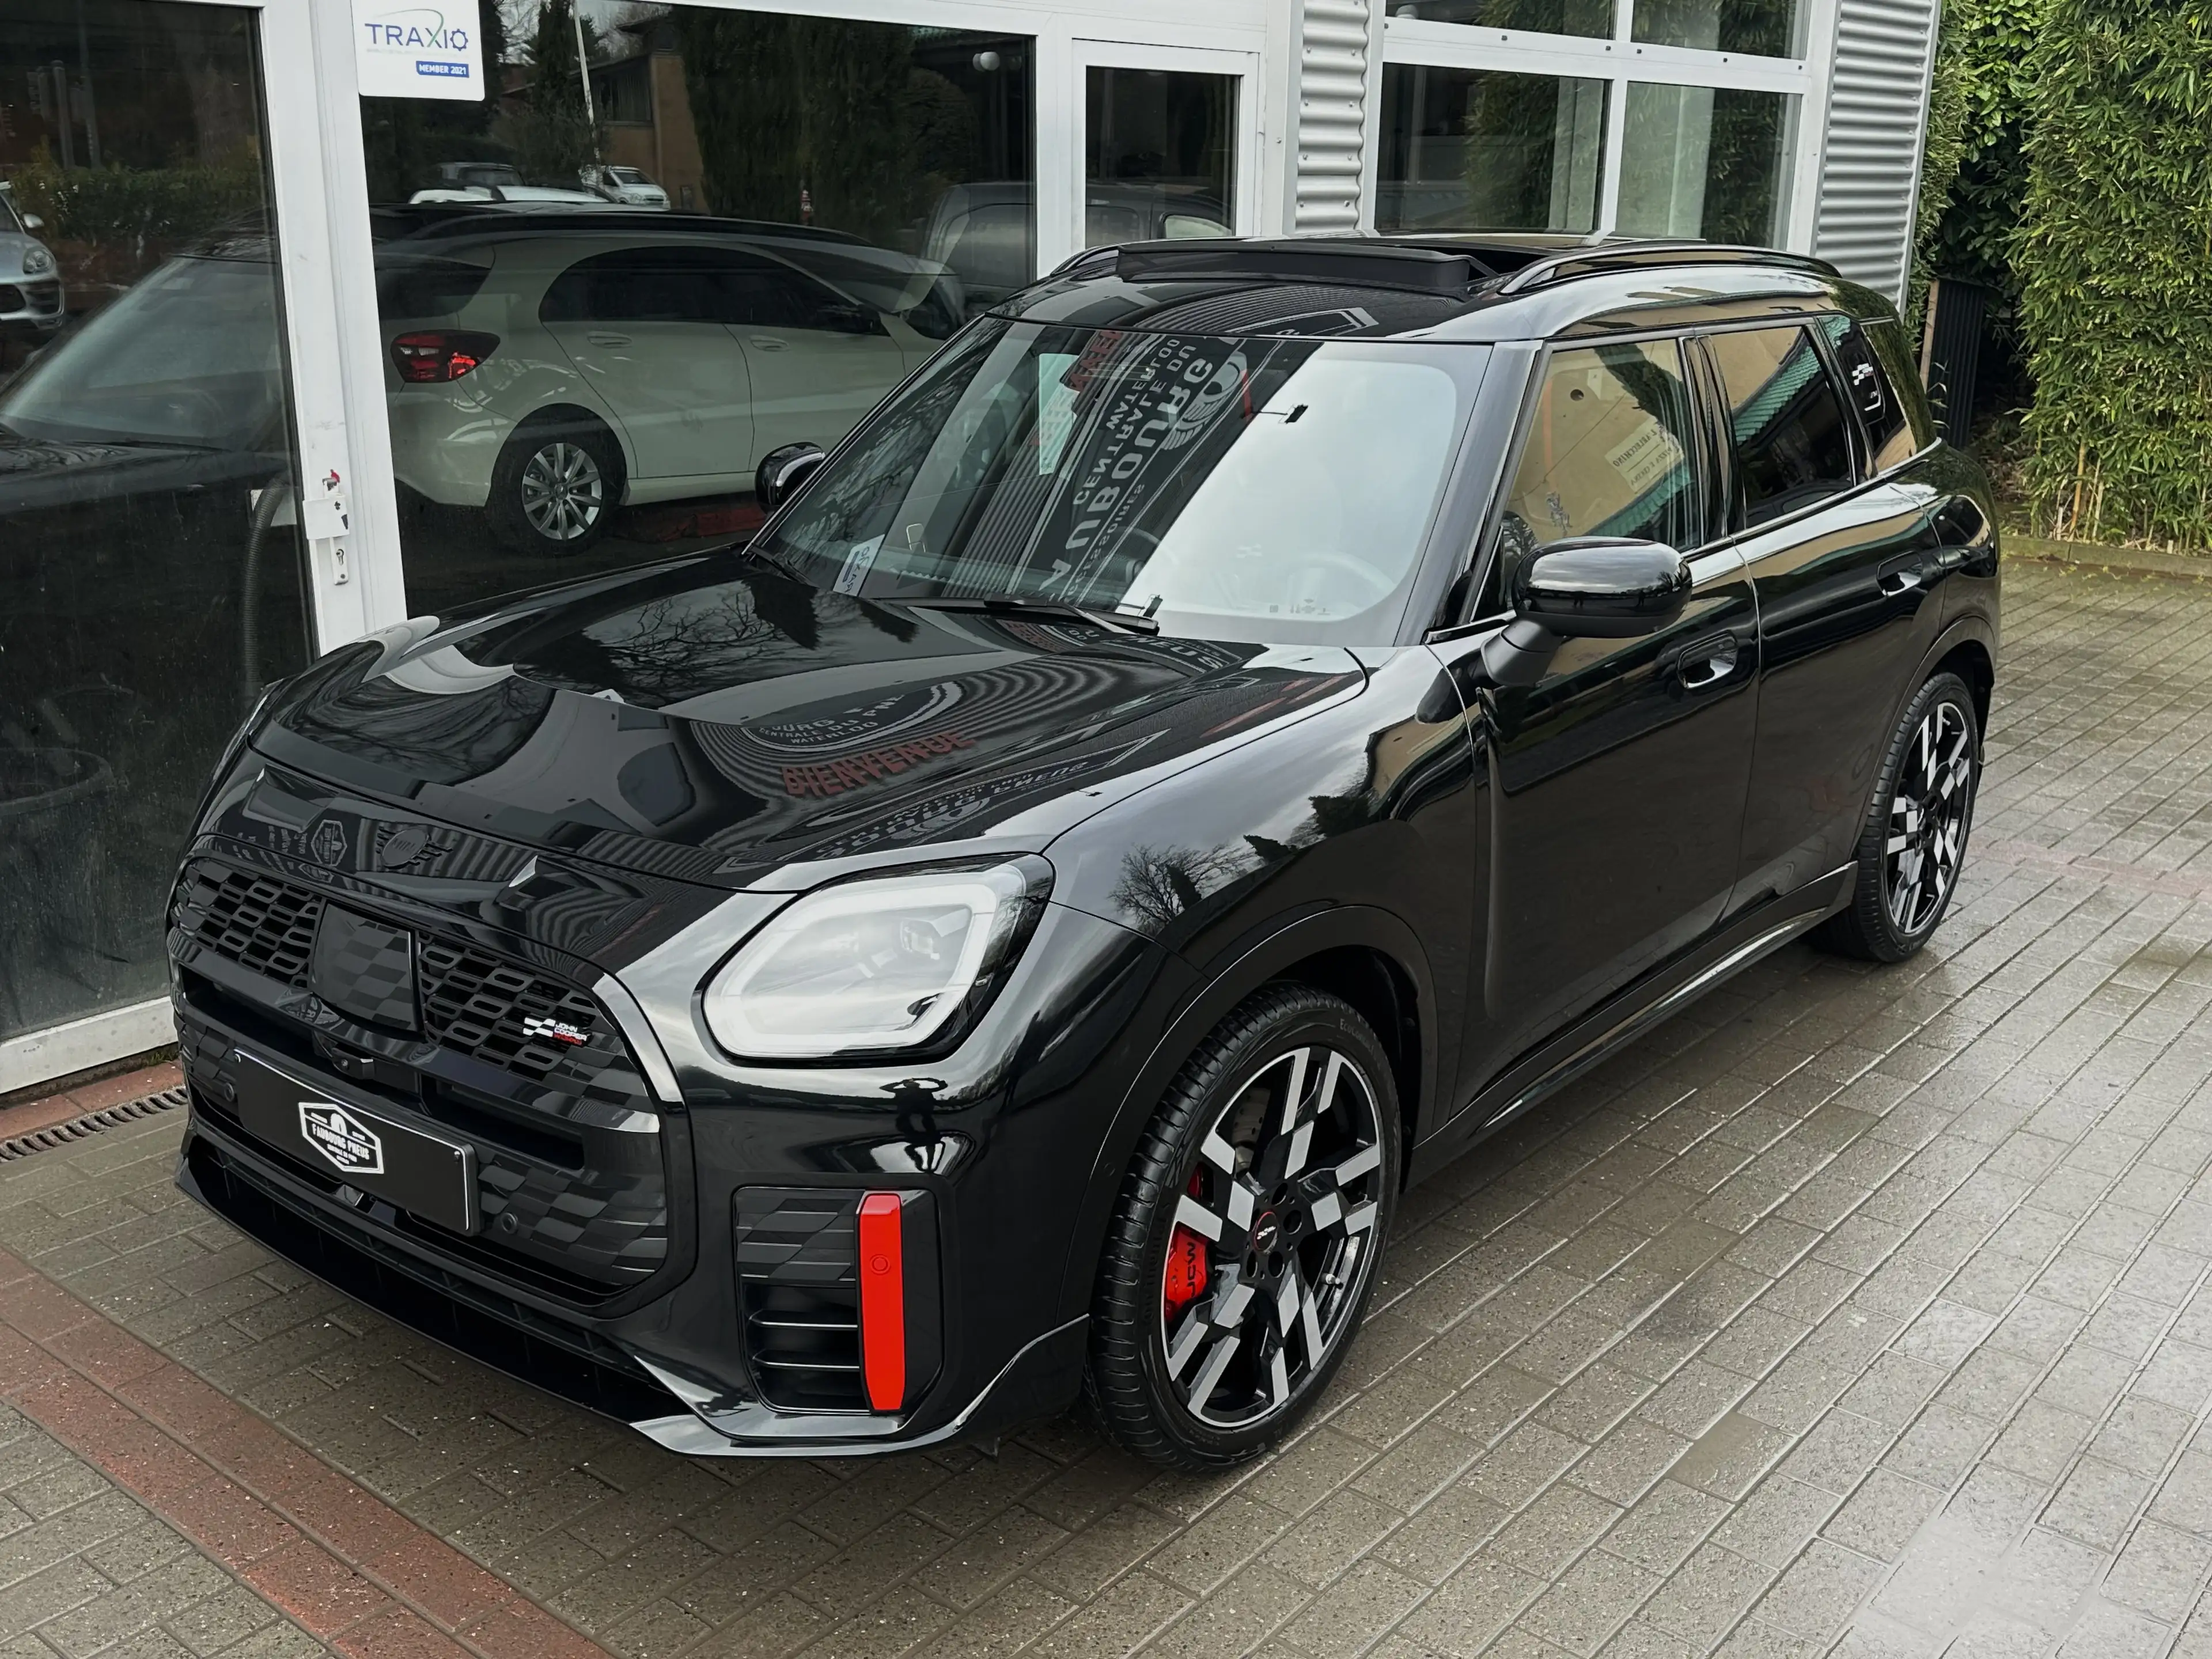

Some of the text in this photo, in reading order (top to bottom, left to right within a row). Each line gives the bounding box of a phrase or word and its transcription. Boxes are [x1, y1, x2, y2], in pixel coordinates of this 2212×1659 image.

[365, 24, 468, 51] TRAXIO
[419, 64, 467, 74] MEMBER 2021
[790, 722, 878, 744] WATERLOO
[781, 730, 976, 797] BIENVENUE
[554, 1027, 588, 1041] COOPER
[1187, 1242, 1196, 1298] JCW
